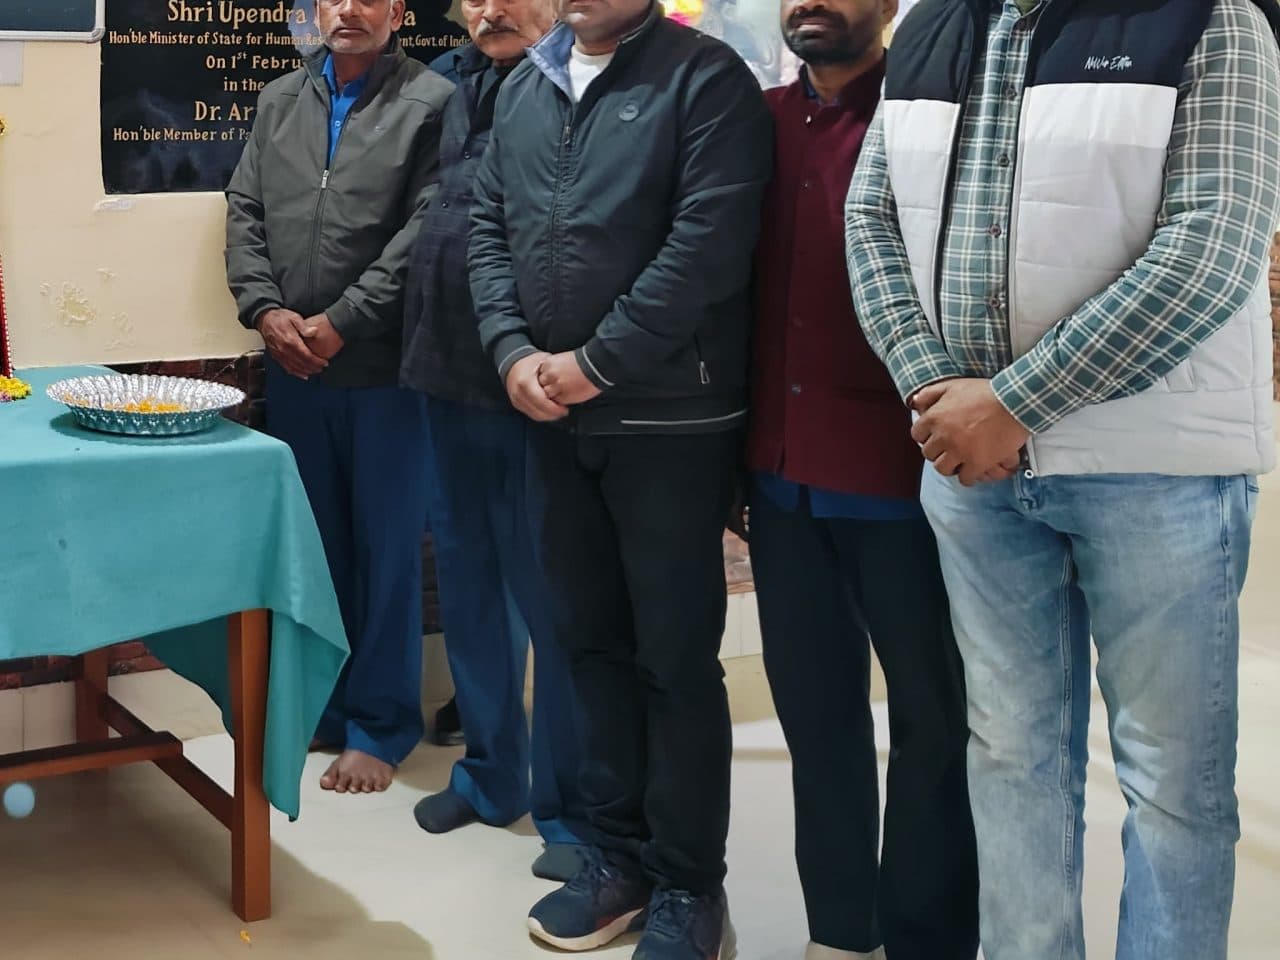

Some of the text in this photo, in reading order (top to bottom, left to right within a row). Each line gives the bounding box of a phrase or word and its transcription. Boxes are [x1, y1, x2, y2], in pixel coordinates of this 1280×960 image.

[219, 0, 307, 30] Upendra
[109, 27, 147, 45] Hon'ble
[149, 31, 195, 46] Minister
[197, 30, 210, 46] of
[212, 32, 244, 46] State
[246, 31, 264, 46] for
[206, 54, 226, 69] On
[252, 55, 302, 70] Febru
[224, 76, 265, 92] in the
[194, 100, 254, 121] Dr. Ar
[113, 125, 161, 142] Hon'ble
[163, 127, 218, 142] Member
[221, 127, 235, 142] of
